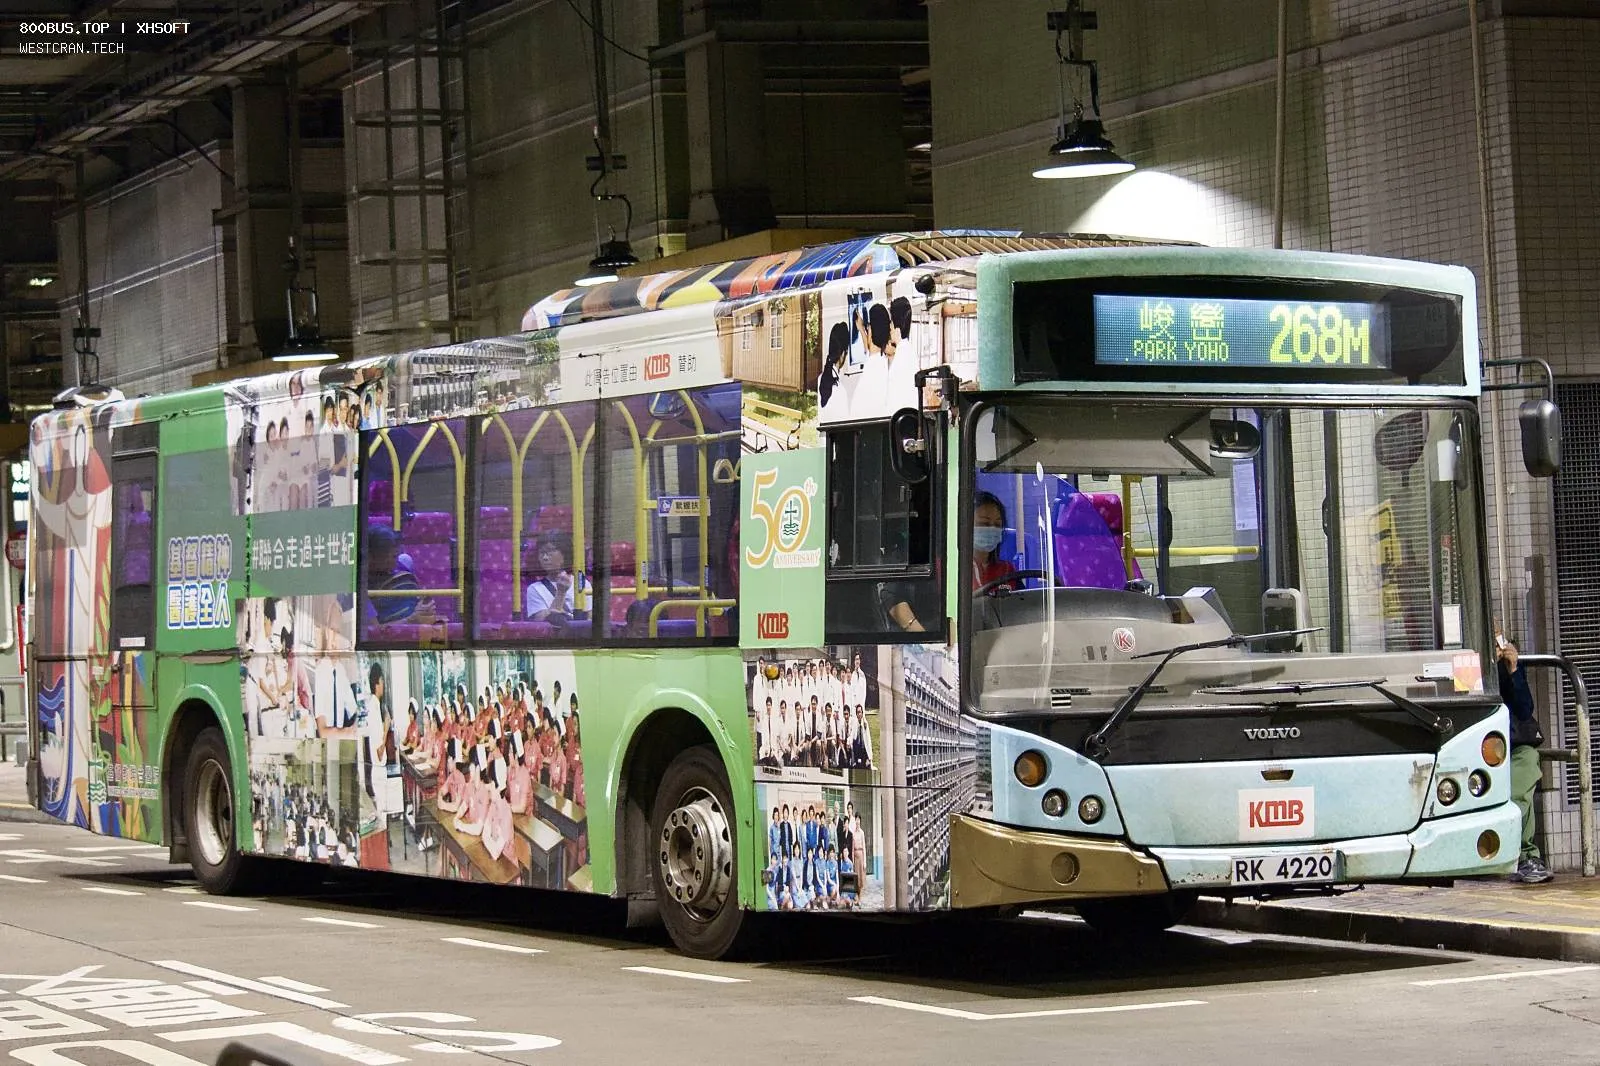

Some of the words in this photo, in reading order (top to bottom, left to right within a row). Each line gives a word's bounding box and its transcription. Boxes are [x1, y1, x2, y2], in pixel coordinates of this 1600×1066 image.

[1268, 303, 1370, 365] 268M
[1133, 339, 1178, 361] PARK
[1184, 340, 1230, 363] YOHO
[643, 353, 672, 381] KMB
[757, 612, 790, 640] KMB
[1243, 726, 1301, 740] VOLVO
[1249, 799, 1305, 828] KMB
[1235, 859, 1265, 882] RK
[1276, 855, 1333, 880] 4220
